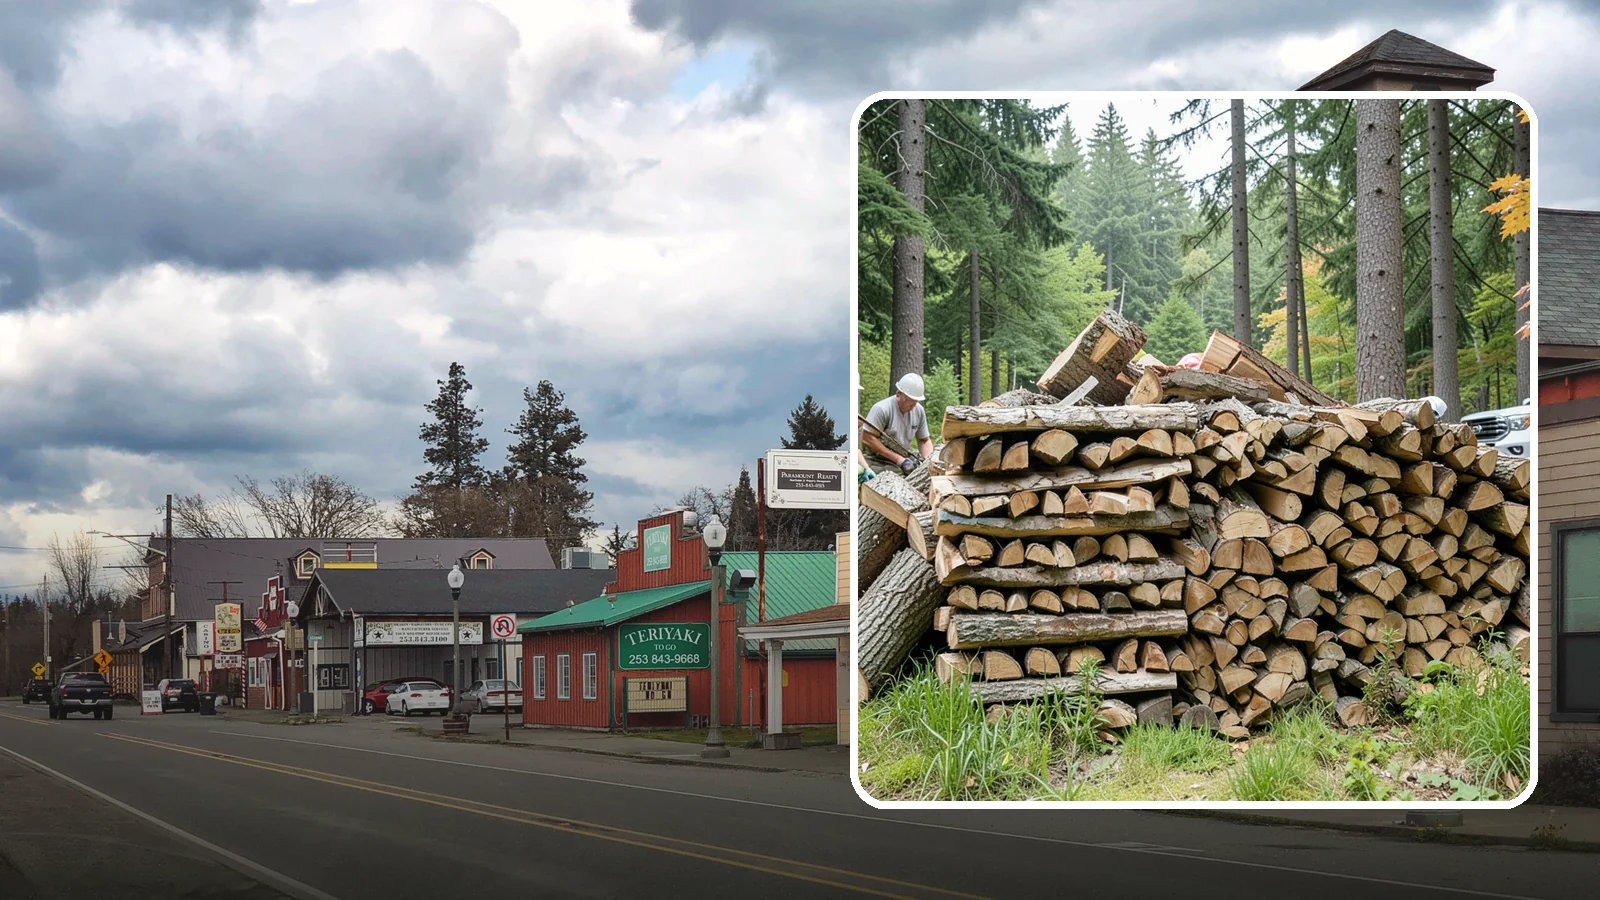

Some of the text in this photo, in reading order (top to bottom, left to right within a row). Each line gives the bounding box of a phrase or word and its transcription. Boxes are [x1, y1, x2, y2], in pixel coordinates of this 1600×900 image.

[781, 471, 839, 480] PARAMOUNT REALTY
[625, 627, 702, 646] TERIYAKI
[628, 654, 700, 664] 253 843-9668
